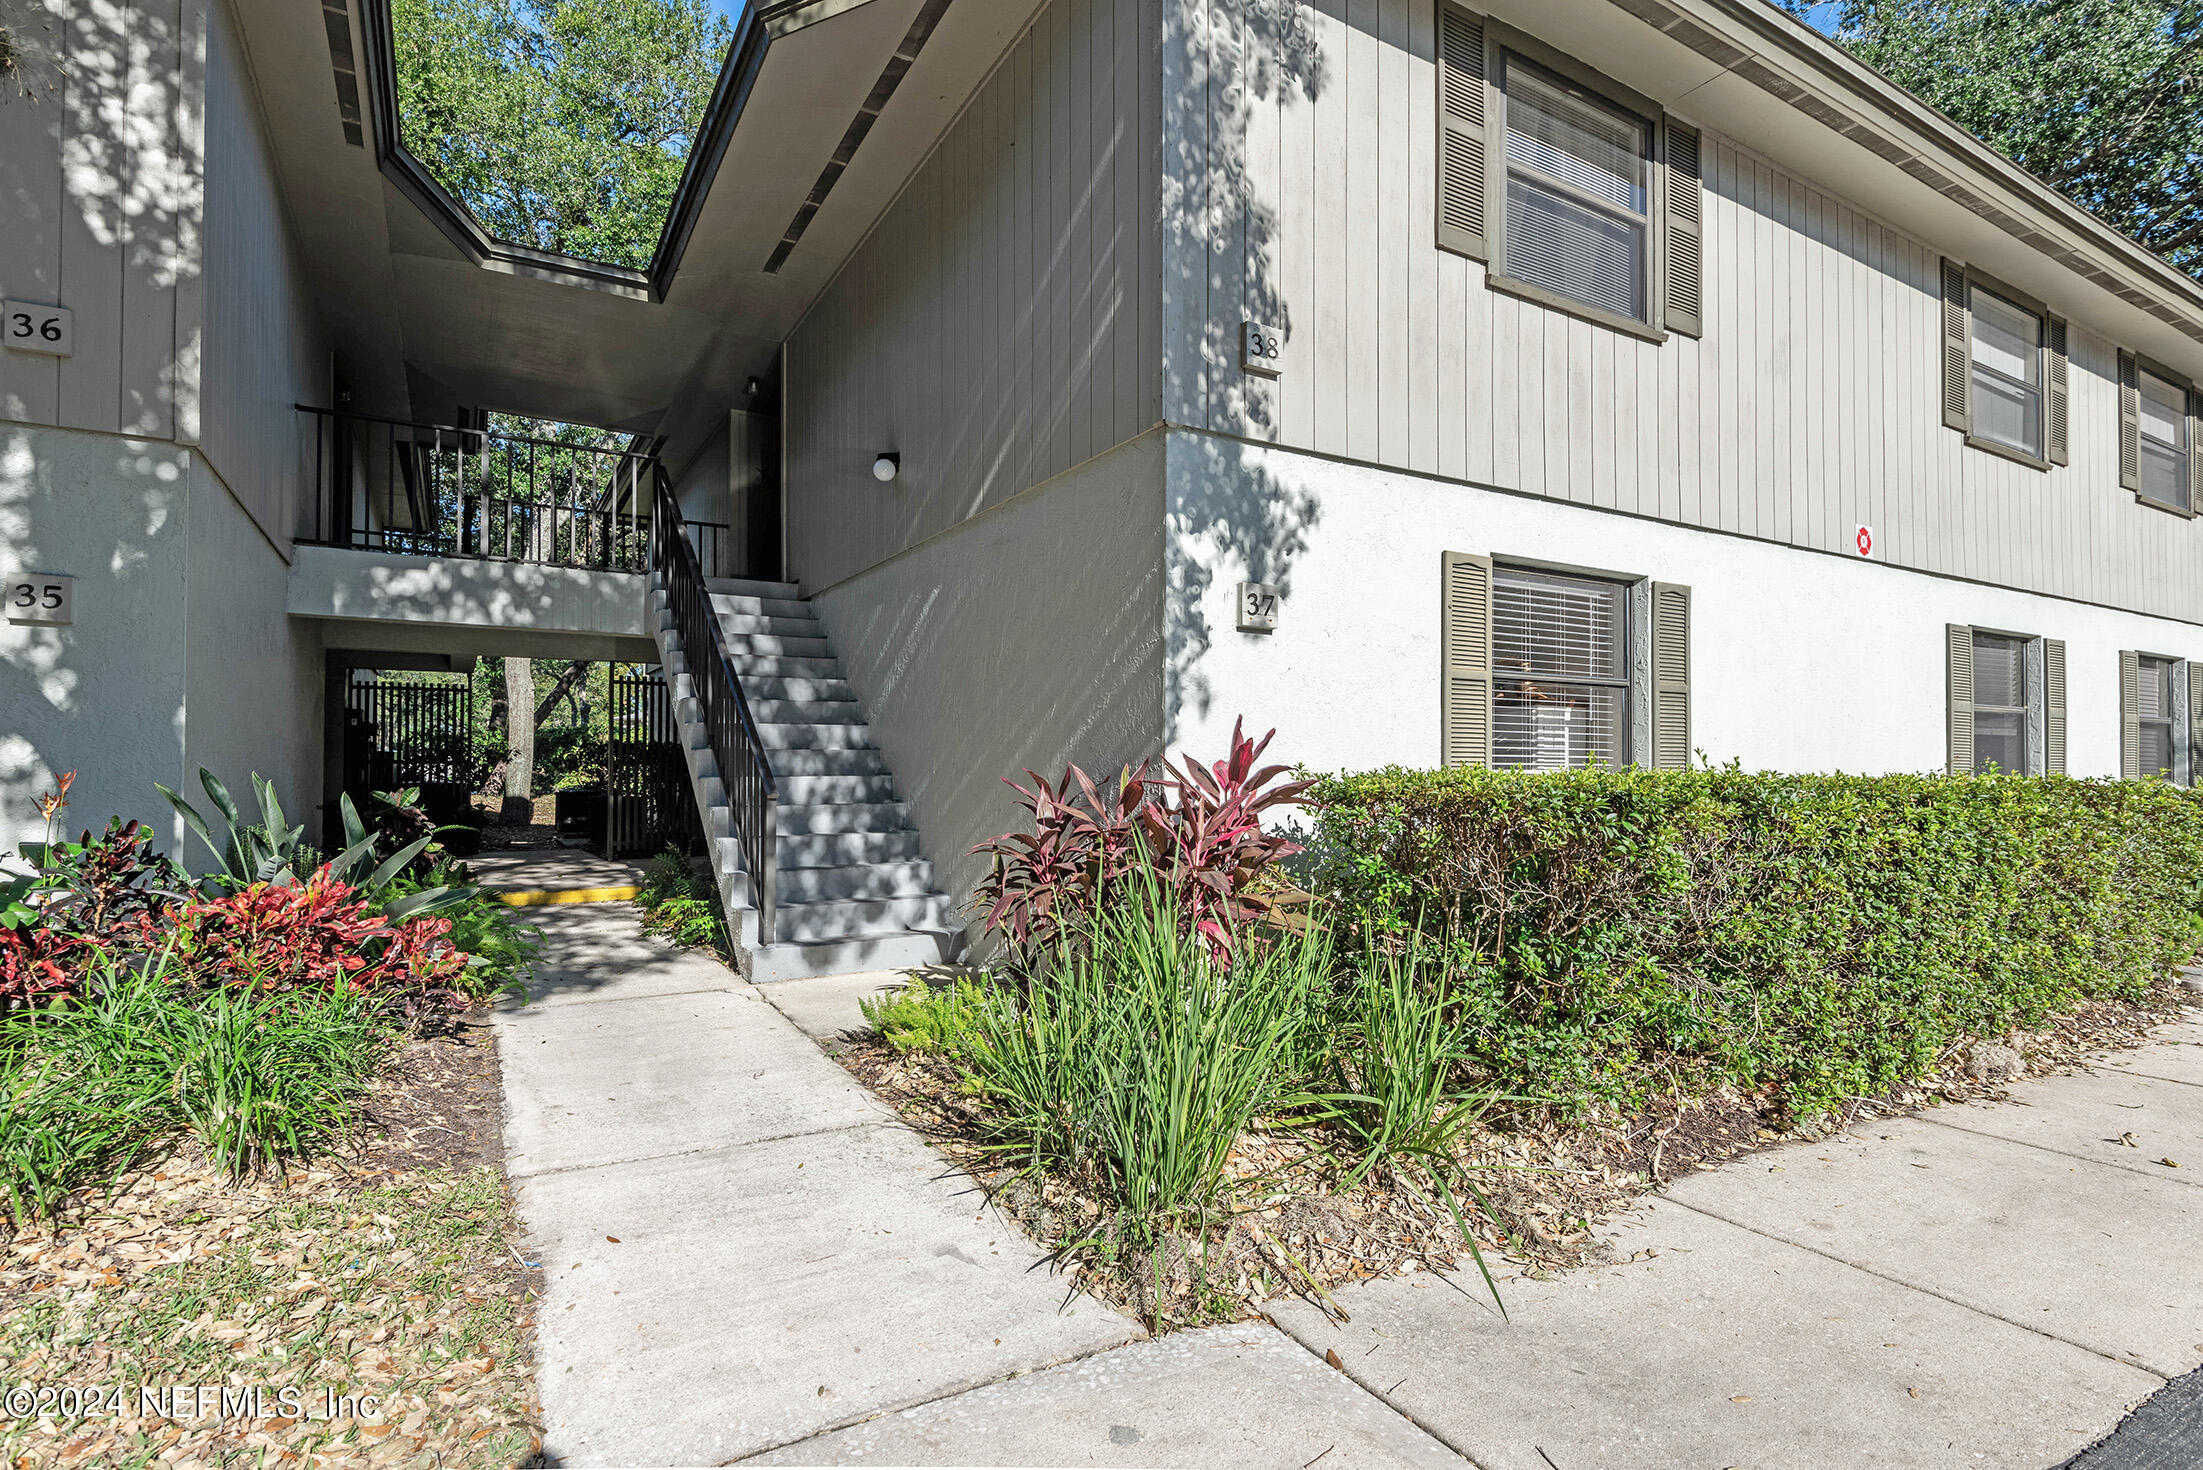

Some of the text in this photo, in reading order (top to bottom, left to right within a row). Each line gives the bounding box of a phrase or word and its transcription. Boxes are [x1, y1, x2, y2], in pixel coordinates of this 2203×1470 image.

[13, 313, 61, 341] 36
[1251, 333, 1279, 359] 38
[15, 583, 63, 609] 35
[1247, 593, 1274, 616] 37
